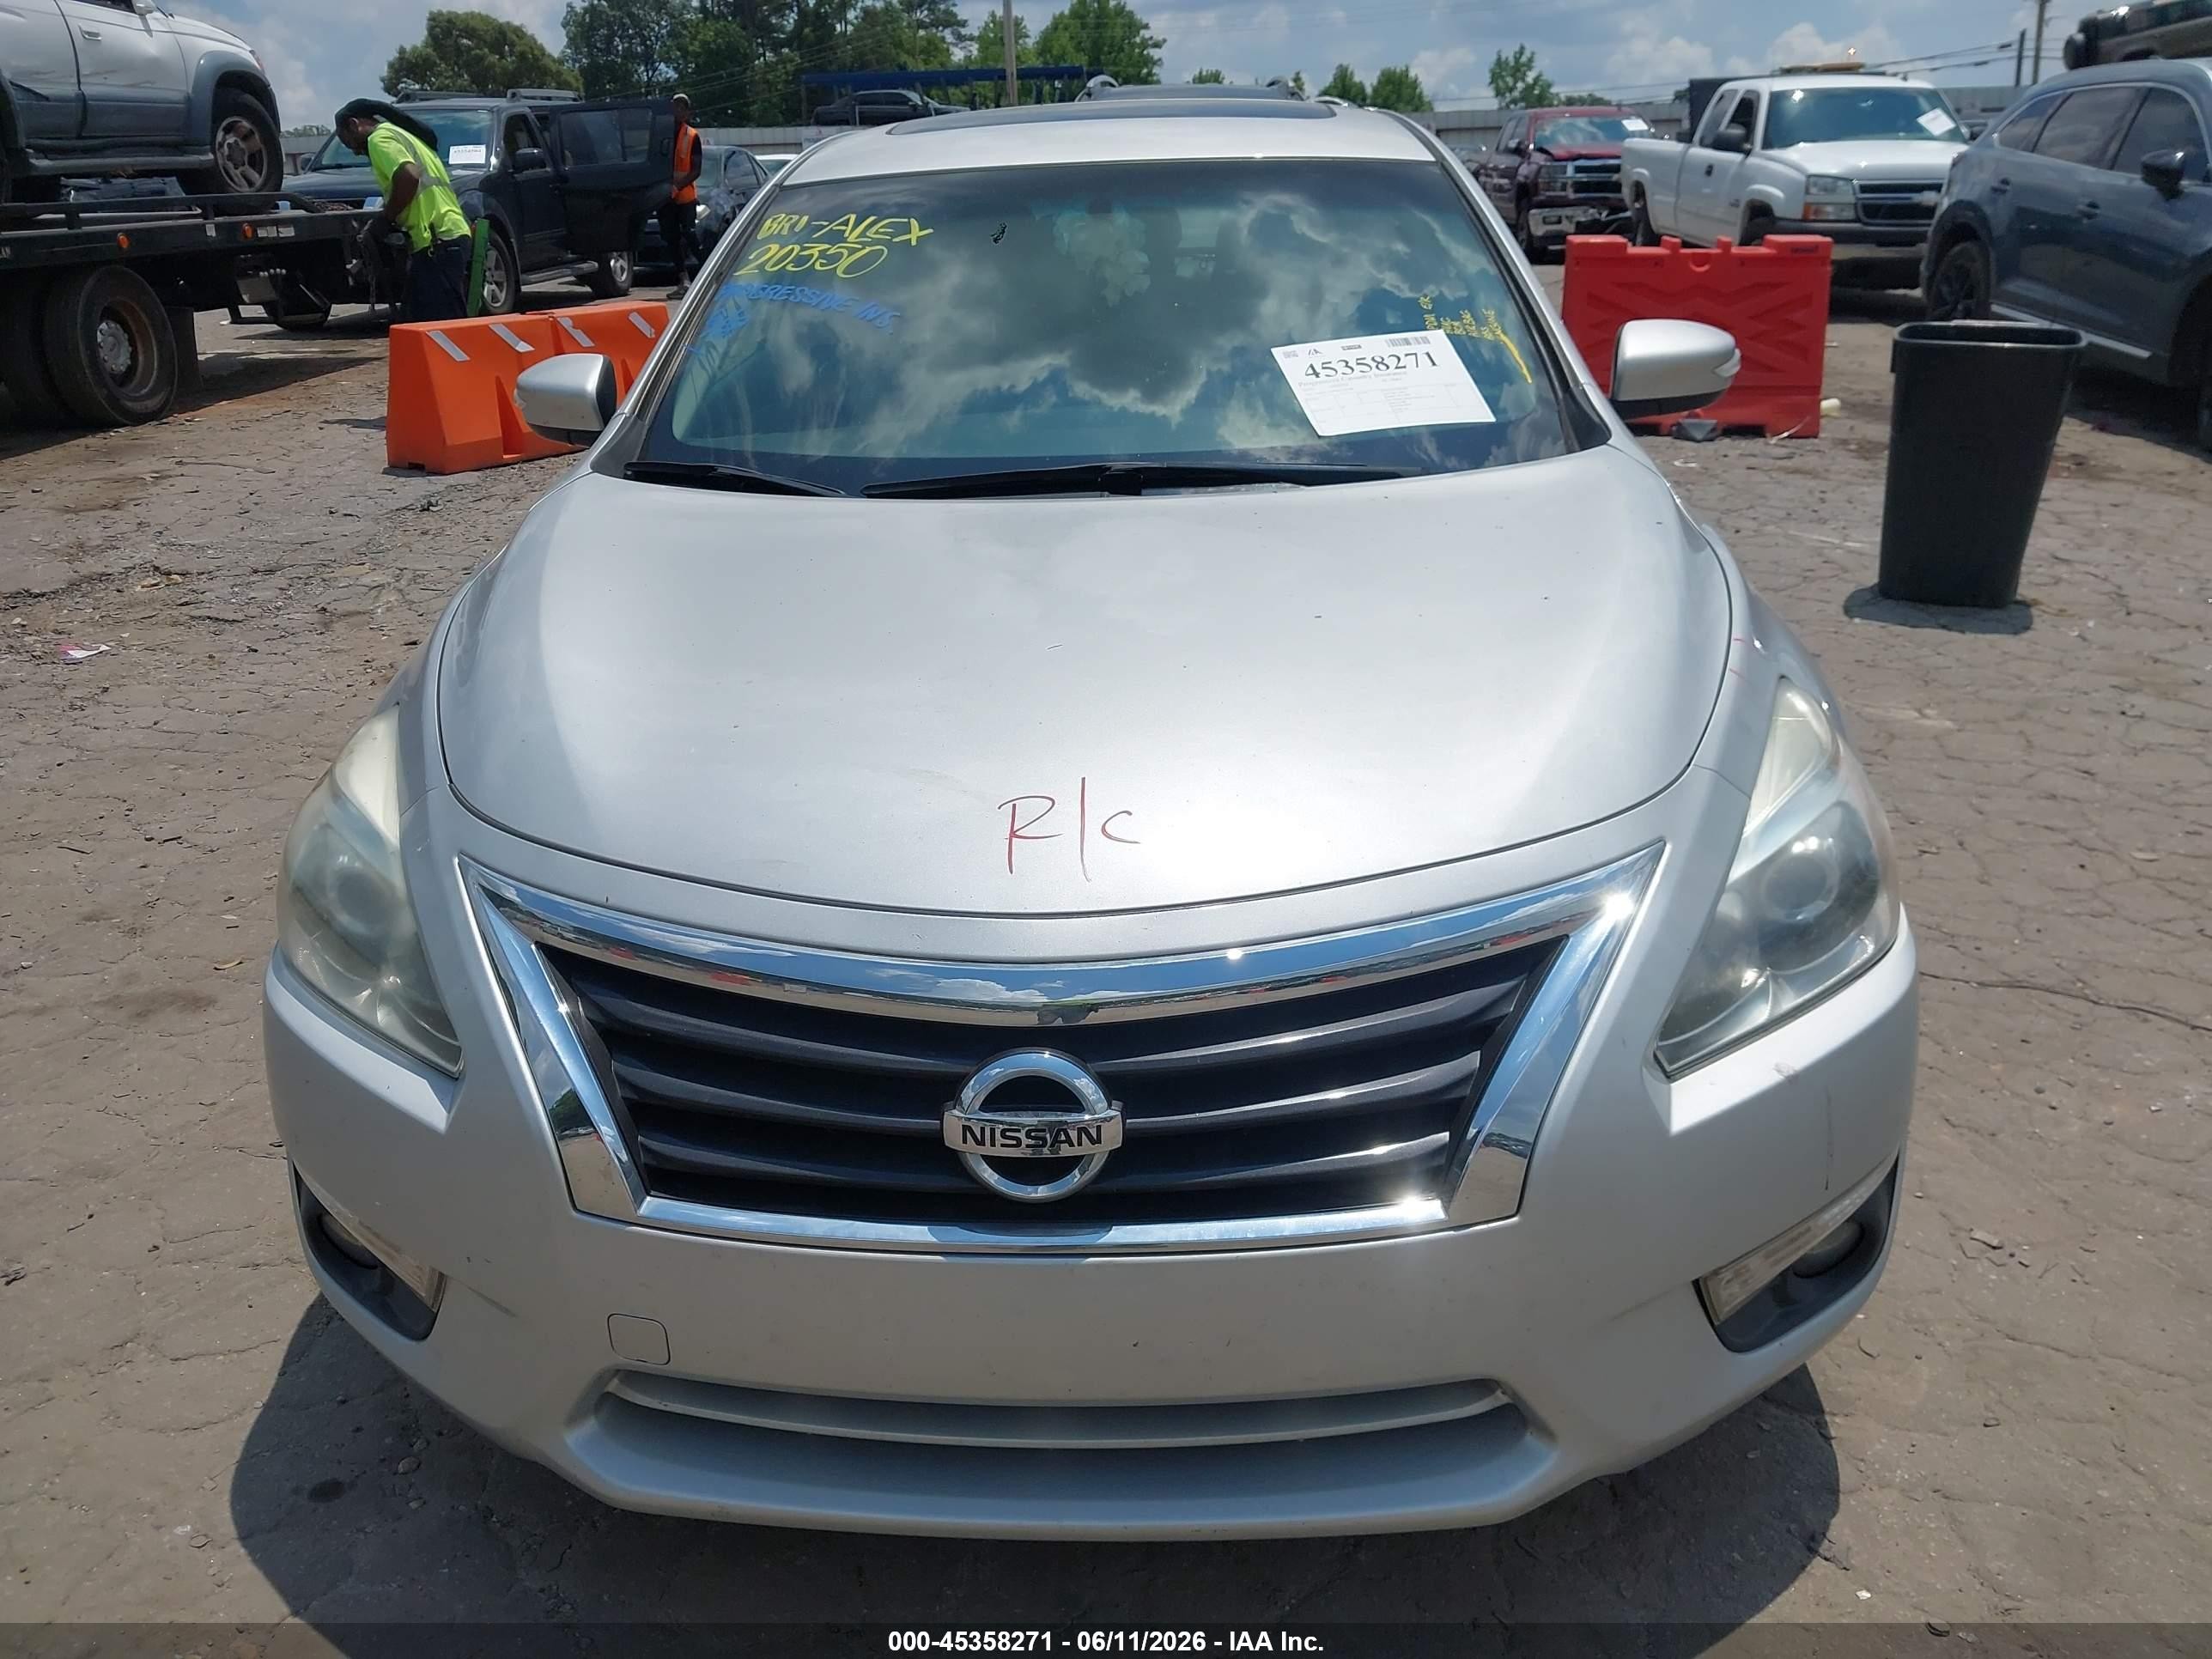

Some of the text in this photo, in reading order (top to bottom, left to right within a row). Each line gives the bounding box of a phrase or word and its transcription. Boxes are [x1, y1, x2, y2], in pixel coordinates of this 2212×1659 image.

[733, 243, 888, 278] 20350
[1304, 351, 1439, 379] 45358271
[962, 1124, 1103, 1149] NISSAN
